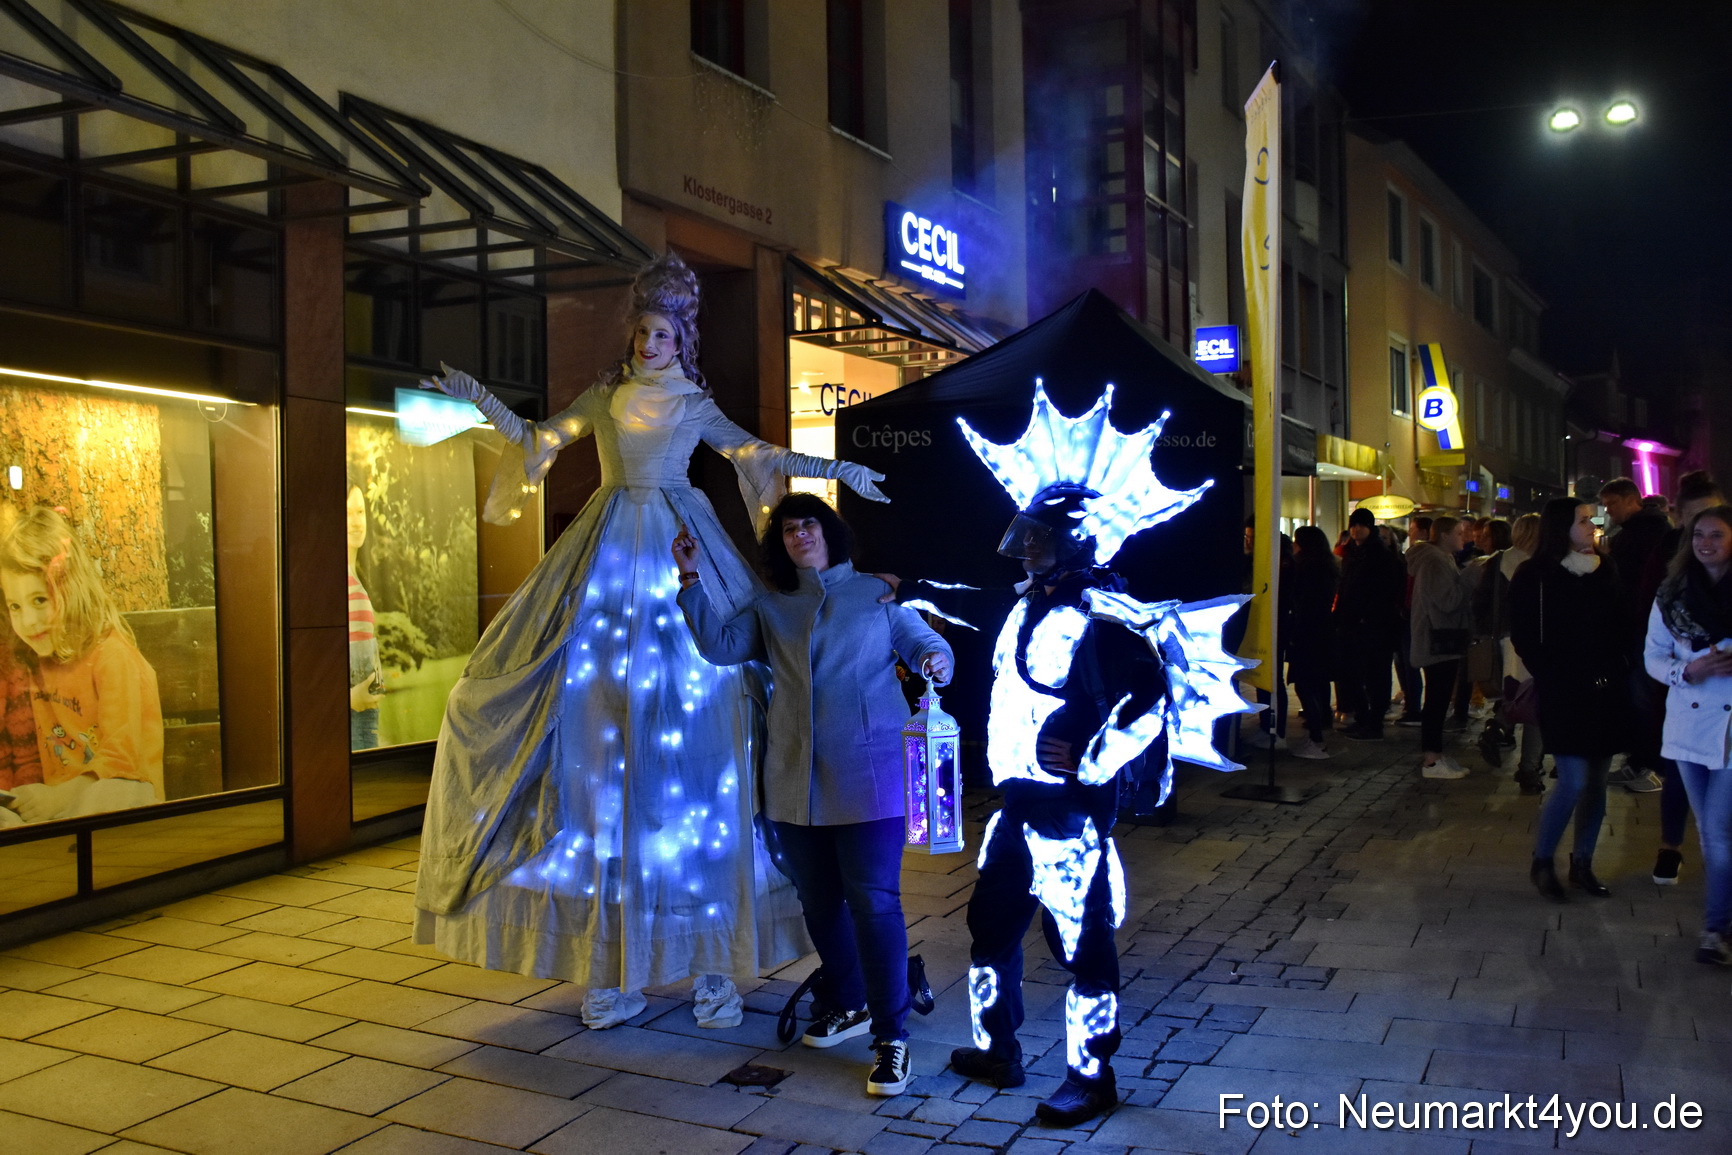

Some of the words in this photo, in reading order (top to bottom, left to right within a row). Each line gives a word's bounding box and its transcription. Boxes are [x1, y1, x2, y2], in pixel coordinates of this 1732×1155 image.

[683, 174, 763, 222] Klostergasse
[765, 207, 772, 225] 2
[901, 211, 965, 276] CECIL
[1195, 338, 1235, 356] ECIL
[820, 383, 872, 416] CEC
[1423, 398, 1444, 419] B
[852, 424, 932, 453] Crêpes
